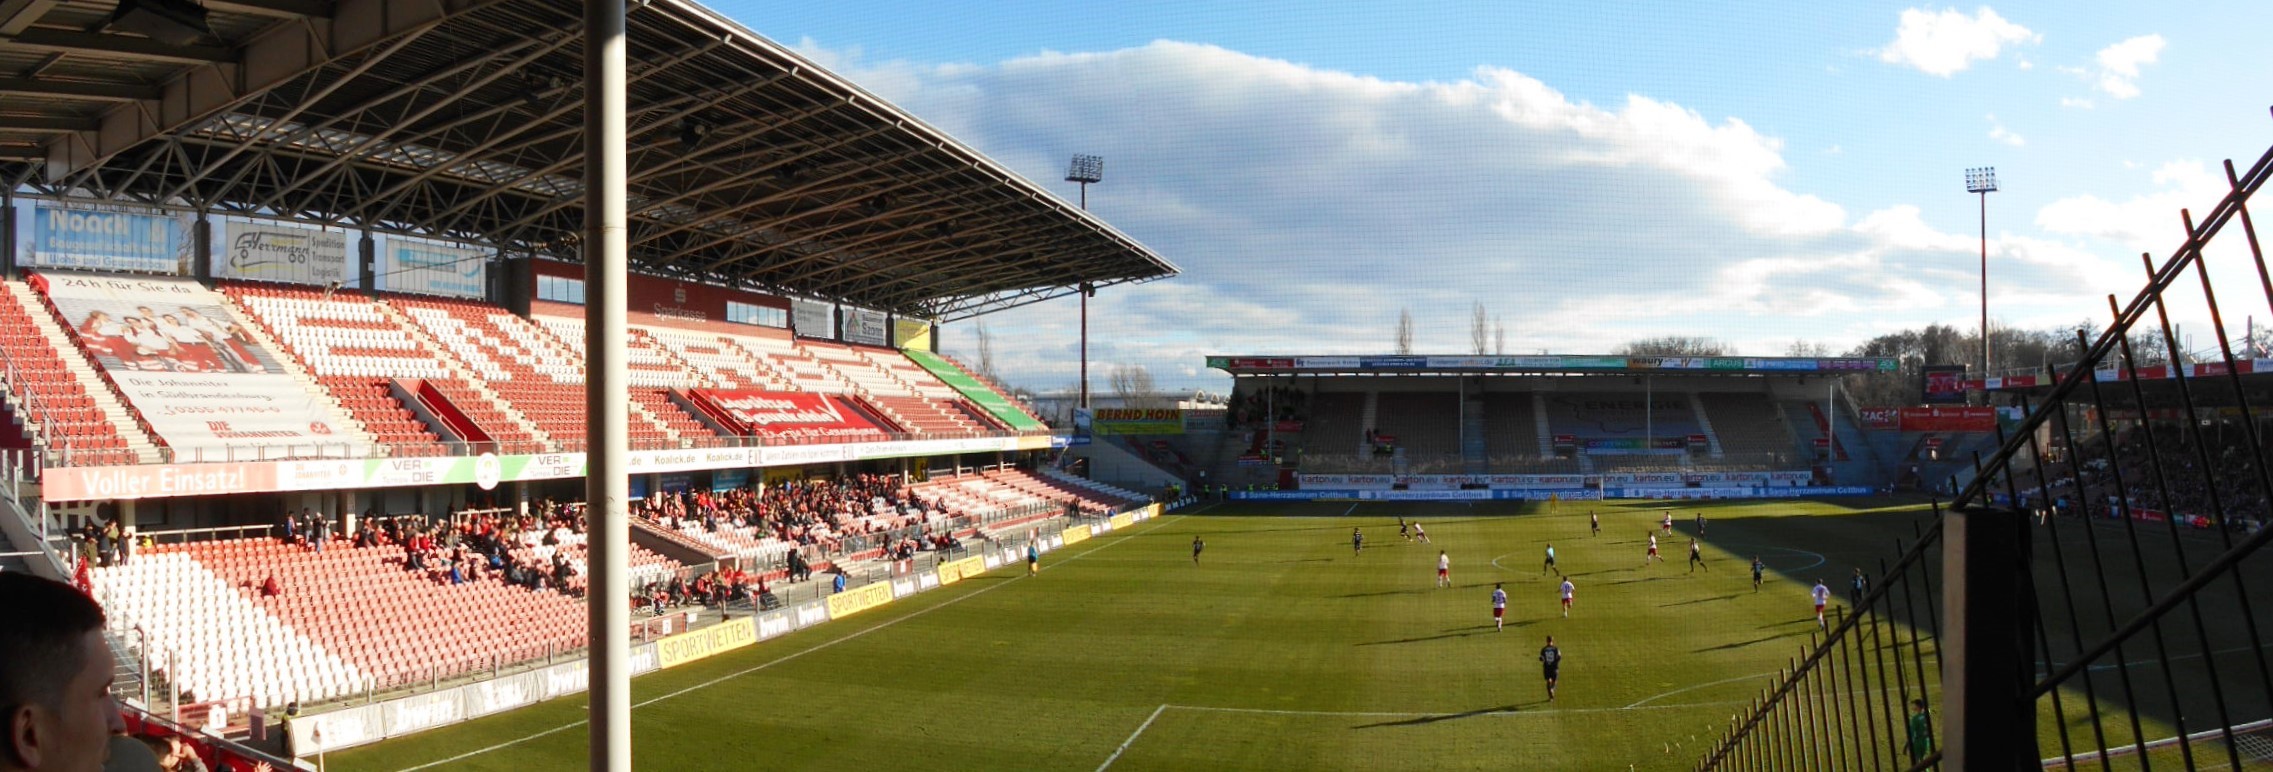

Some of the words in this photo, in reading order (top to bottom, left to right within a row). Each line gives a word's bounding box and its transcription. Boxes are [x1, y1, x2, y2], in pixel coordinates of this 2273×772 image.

[137, 281, 164, 293] Sie
[654, 302, 707, 323] Sparkasse
[207, 420, 233, 431] DIE
[393, 459, 421, 471] VER
[538, 455, 562, 466] VER
[654, 454, 696, 465] Koalick.de
[412, 471, 435, 483] DIE
[553, 465, 571, 477] DIE
[82, 470, 150, 496] Voller
[160, 465, 245, 493] Einsatz!
[830, 584, 889, 614] SPORTWETTEN
[759, 612, 789, 638] bwin
[663, 620, 751, 663] SPORTWETTEN
